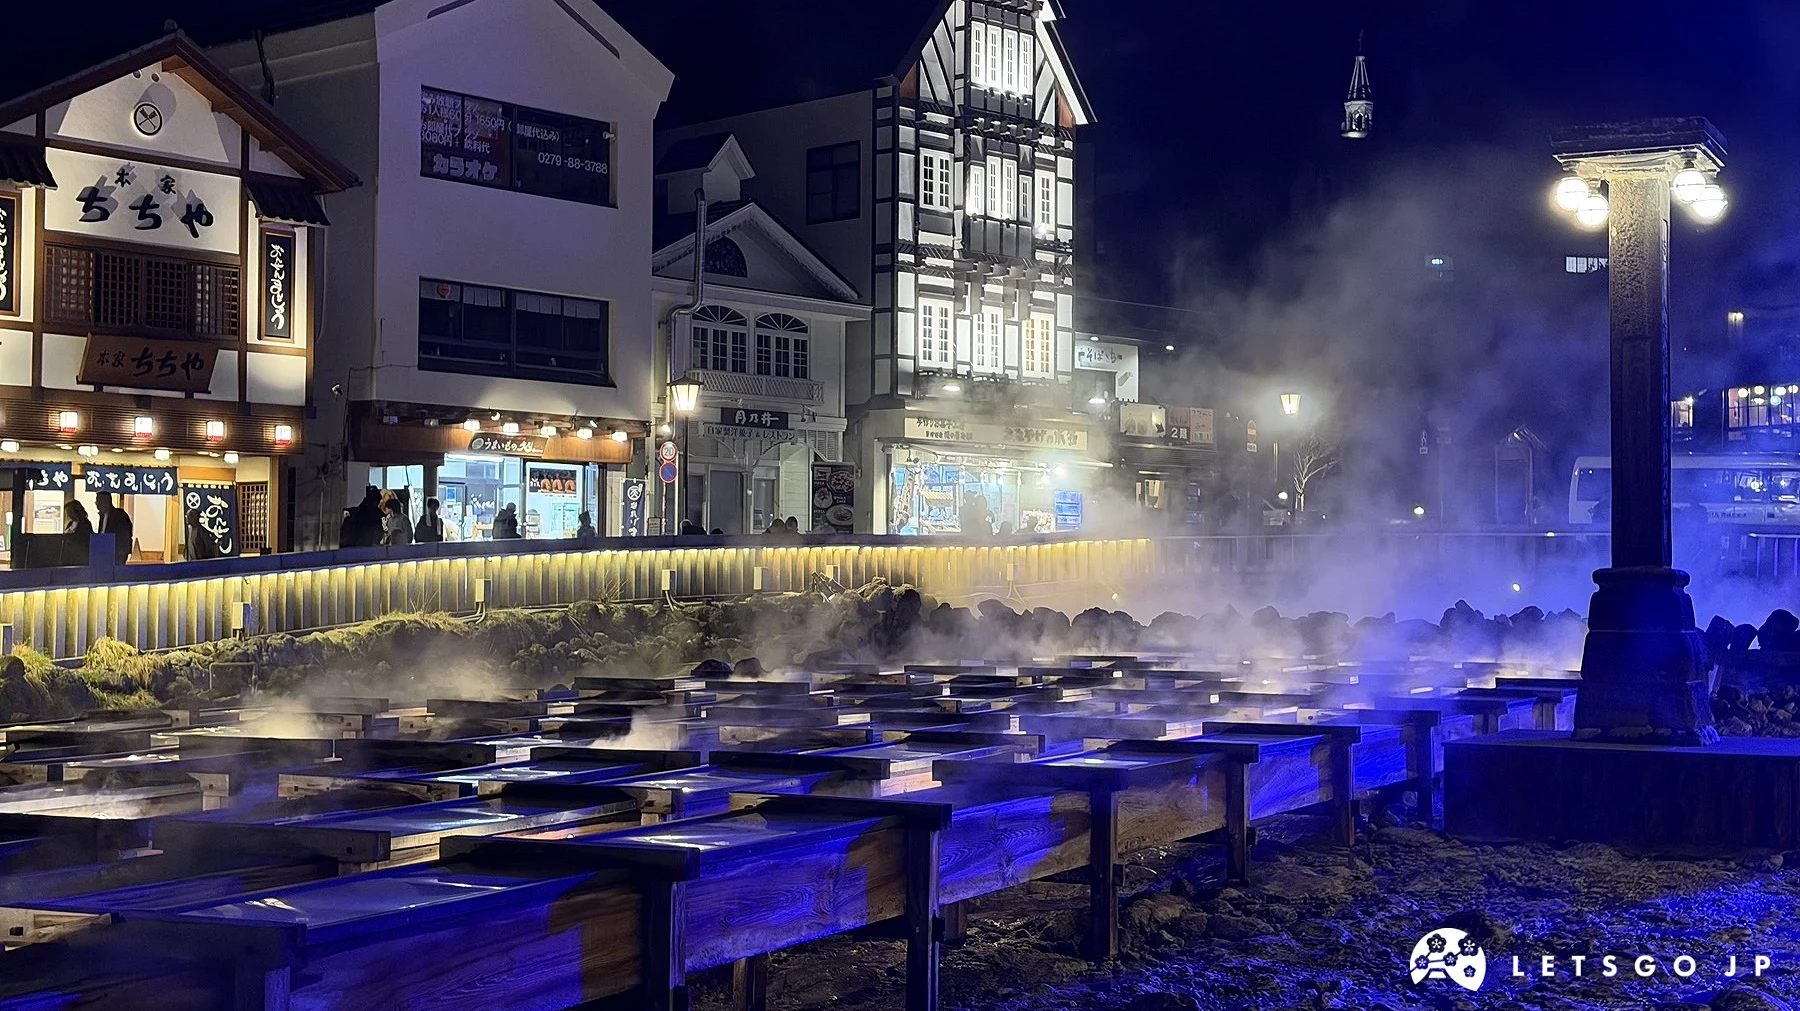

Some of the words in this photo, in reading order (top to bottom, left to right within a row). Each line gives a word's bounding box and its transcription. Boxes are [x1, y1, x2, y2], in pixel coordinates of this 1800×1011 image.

[433, 153, 498, 181] カラオケ
[537, 151, 608, 175] 0279-88-3788
[115, 168, 176, 195] 本家
[75, 185, 214, 238] ちちや
[664, 447, 674, 457] 20
